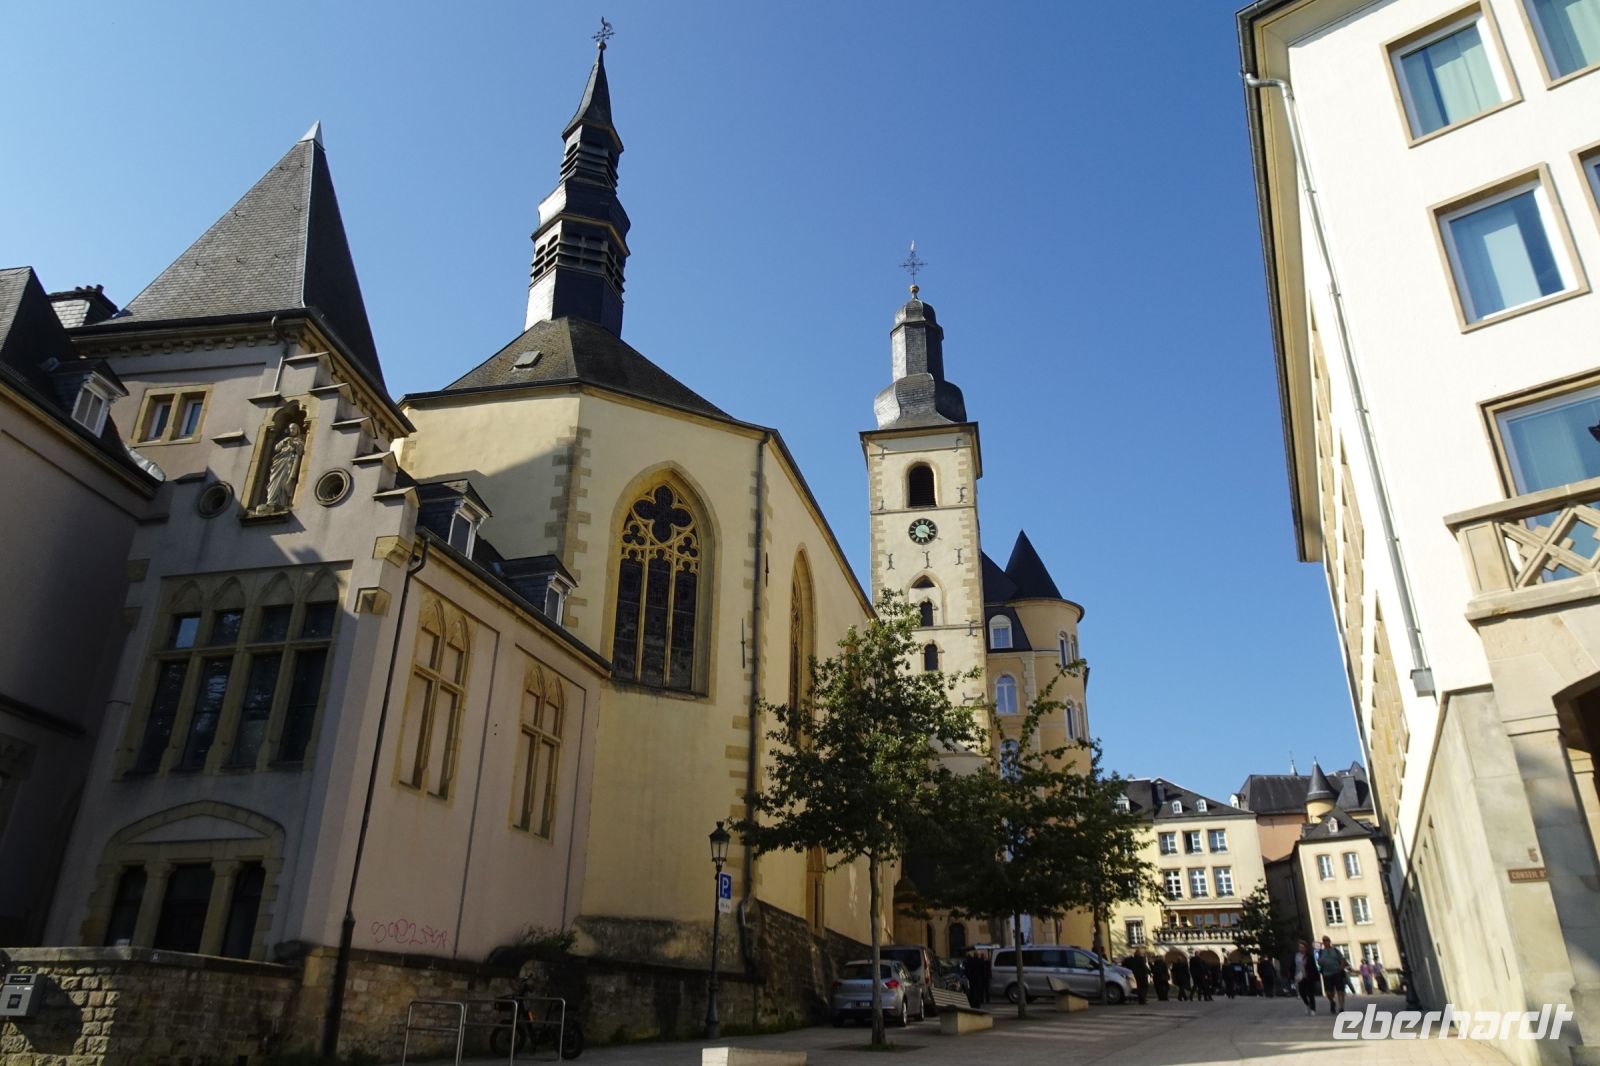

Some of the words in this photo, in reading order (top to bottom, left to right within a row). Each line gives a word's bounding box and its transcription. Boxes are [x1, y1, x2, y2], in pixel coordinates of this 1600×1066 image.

[1527, 848, 1539, 863] 5
[1510, 870, 1539, 880] CONSEIL
[722, 877, 730, 896] P
